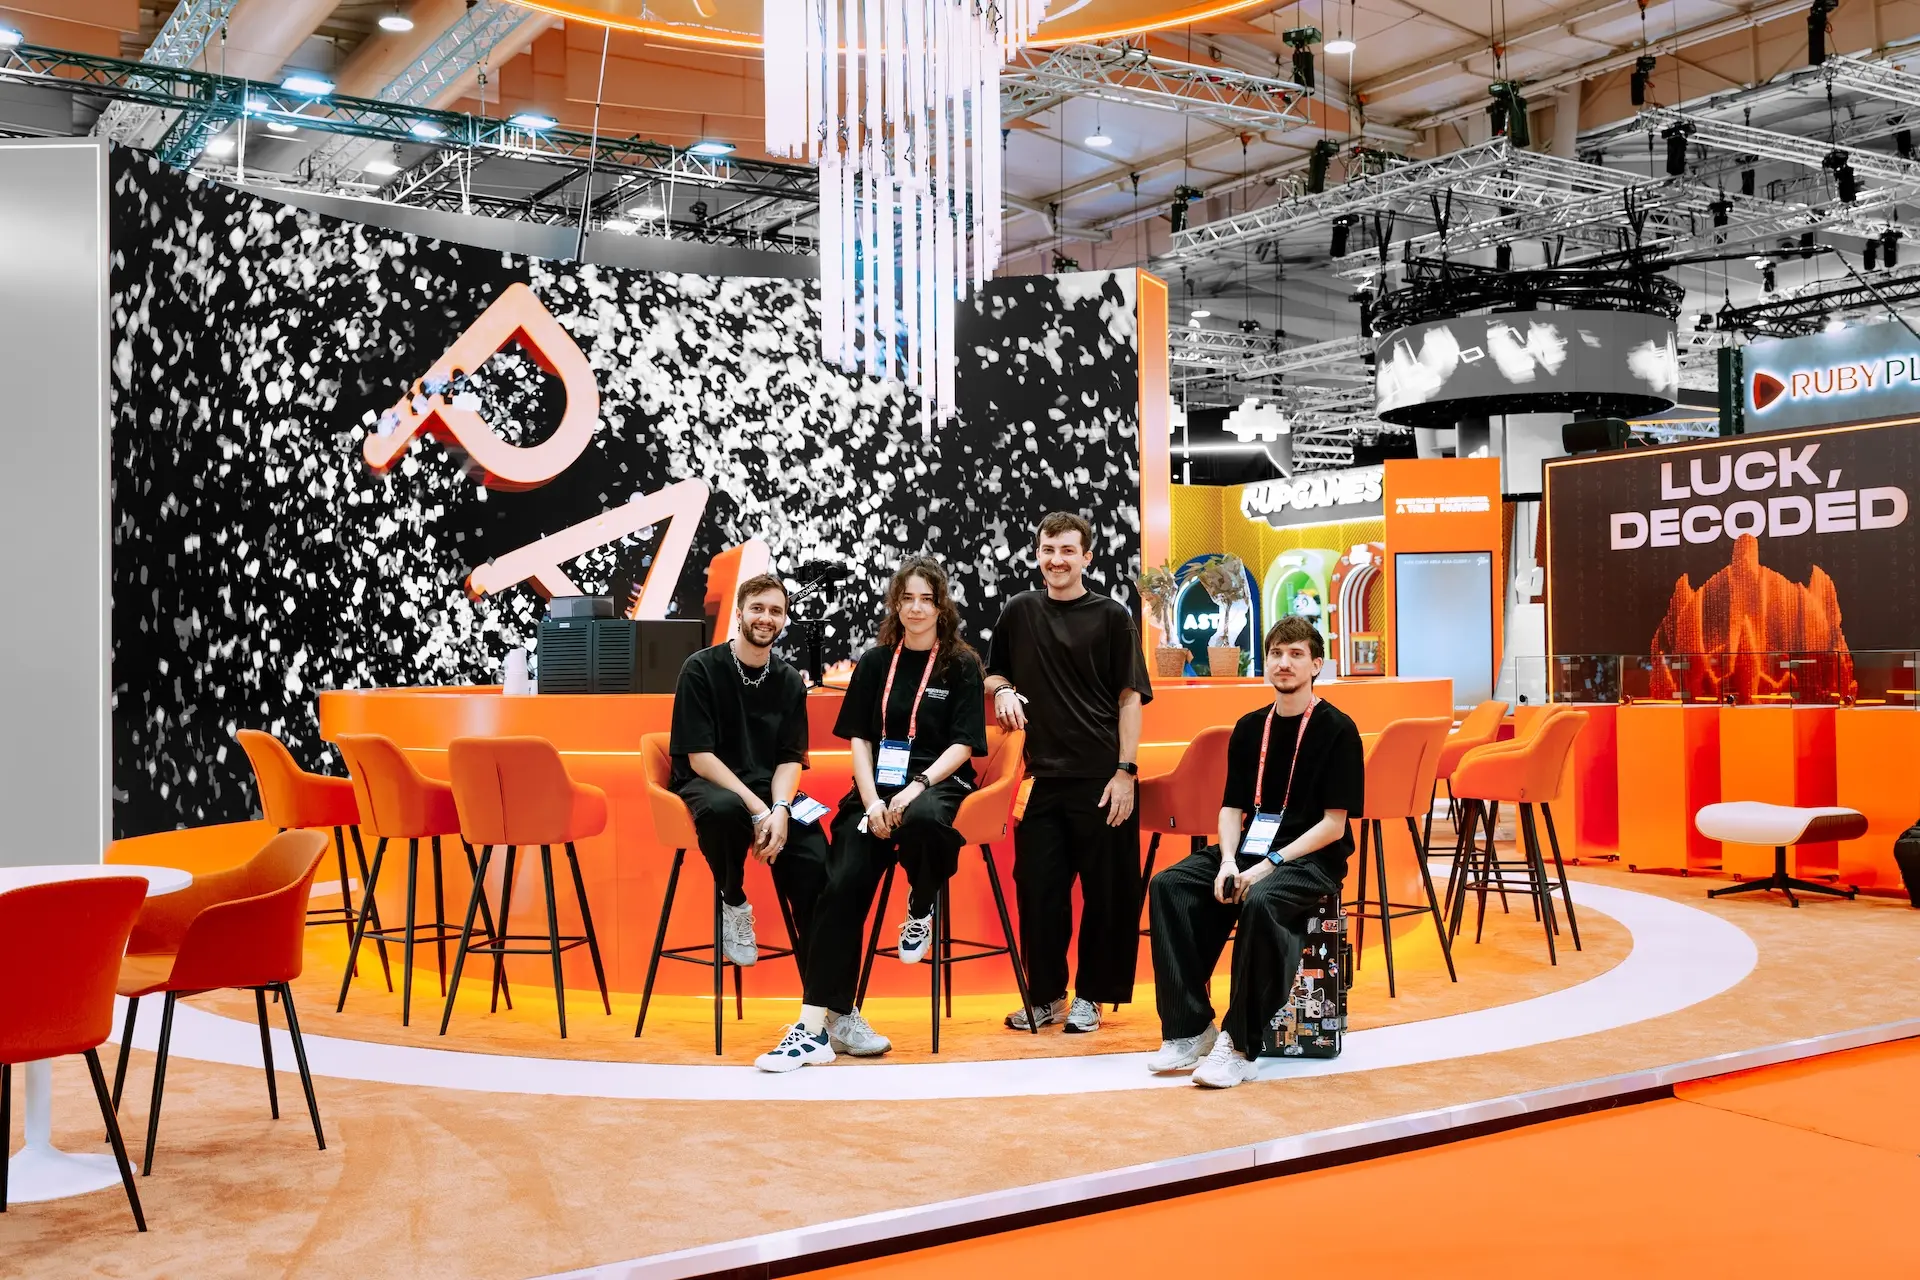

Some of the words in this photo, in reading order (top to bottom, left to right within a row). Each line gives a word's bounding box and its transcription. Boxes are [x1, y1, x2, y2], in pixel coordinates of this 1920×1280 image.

[1661, 443, 1842, 500] LUCK,
[1610, 486, 1909, 550] DECODED
[798, 582, 819, 599] RONIN
